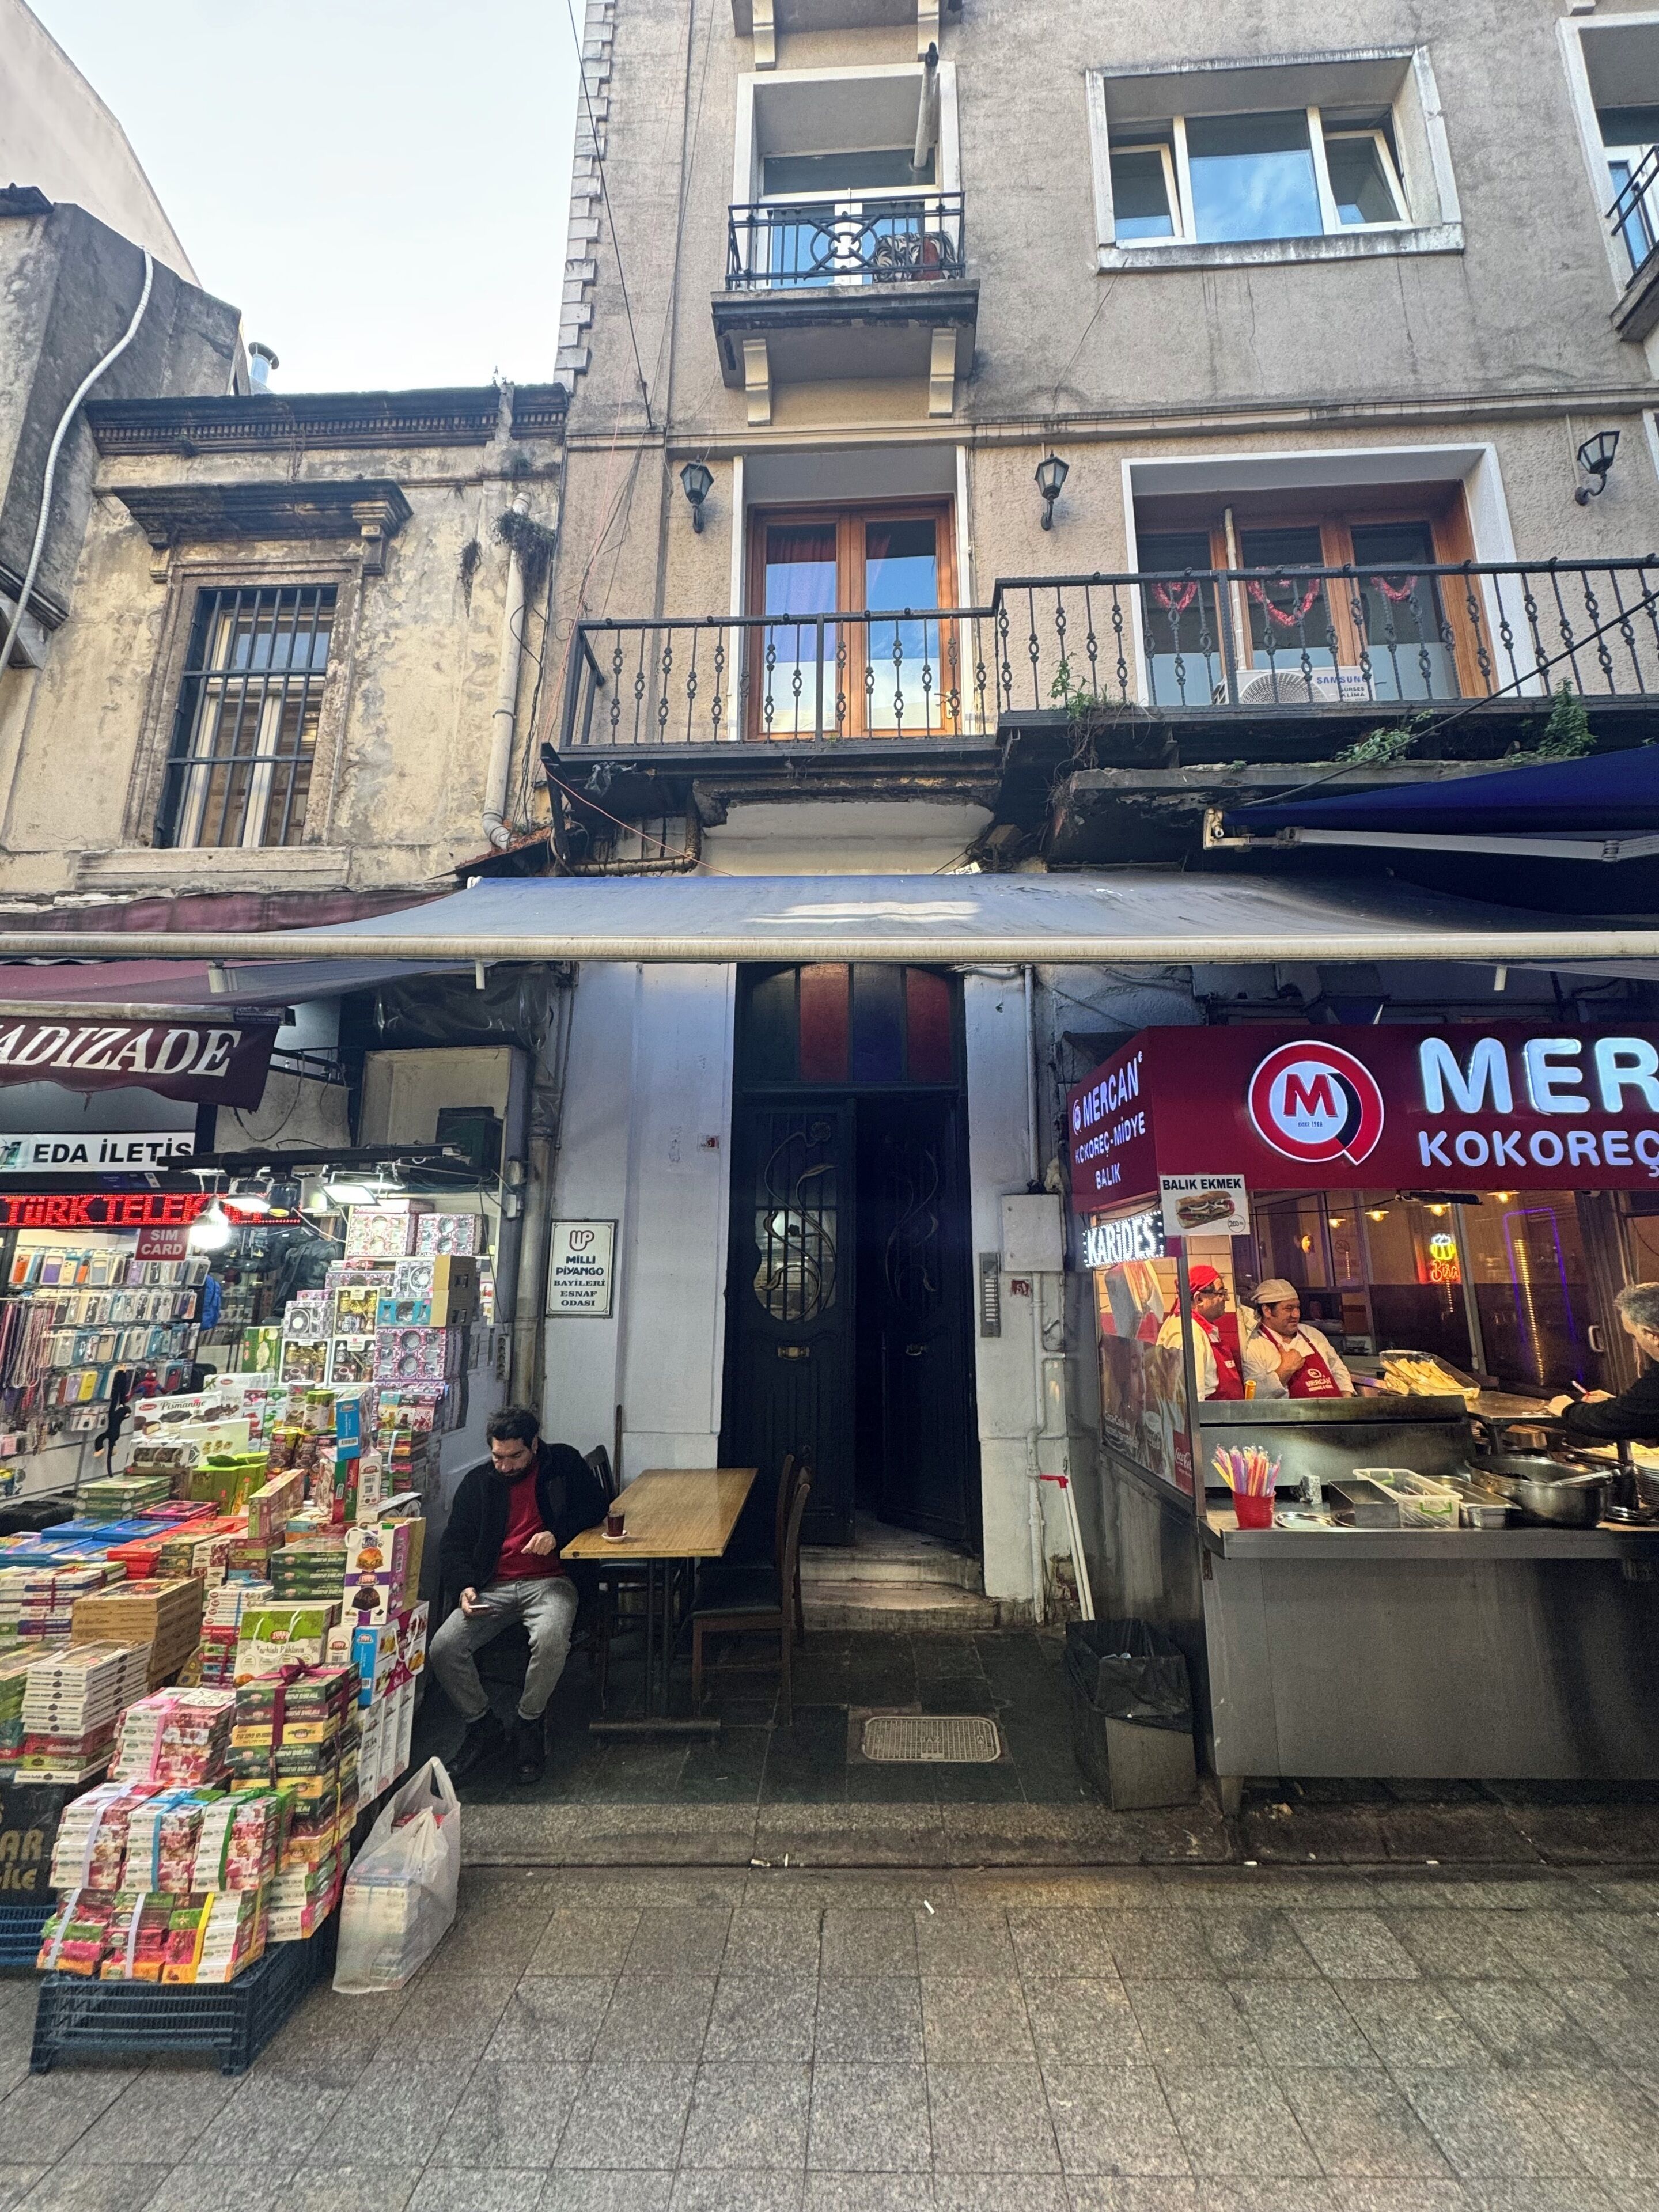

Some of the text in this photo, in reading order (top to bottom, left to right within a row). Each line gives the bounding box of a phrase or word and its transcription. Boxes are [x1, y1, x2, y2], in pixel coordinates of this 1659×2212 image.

[0, 1024, 242, 1077] ADIZADE
[1419, 1037, 1659, 1115] MER
[1082, 1057, 1139, 1128] MERCAN
[32, 1143, 89, 1163] EDA
[1419, 1129, 1659, 1177] KOKOREÇ
[1095, 1162, 1121, 1190] BALIK
[1162, 1178, 1242, 1190] BALIK EKMEK
[150, 1229, 179, 1241] SIM
[141, 1243, 183, 1255] CARD
[566, 1255, 596, 1264] MİLLİ
[556, 1266, 604, 1276] PİYANGO
[1431, 1259, 1459, 1282] Bira
[553, 1278, 605, 1286] BAYİLERİ
